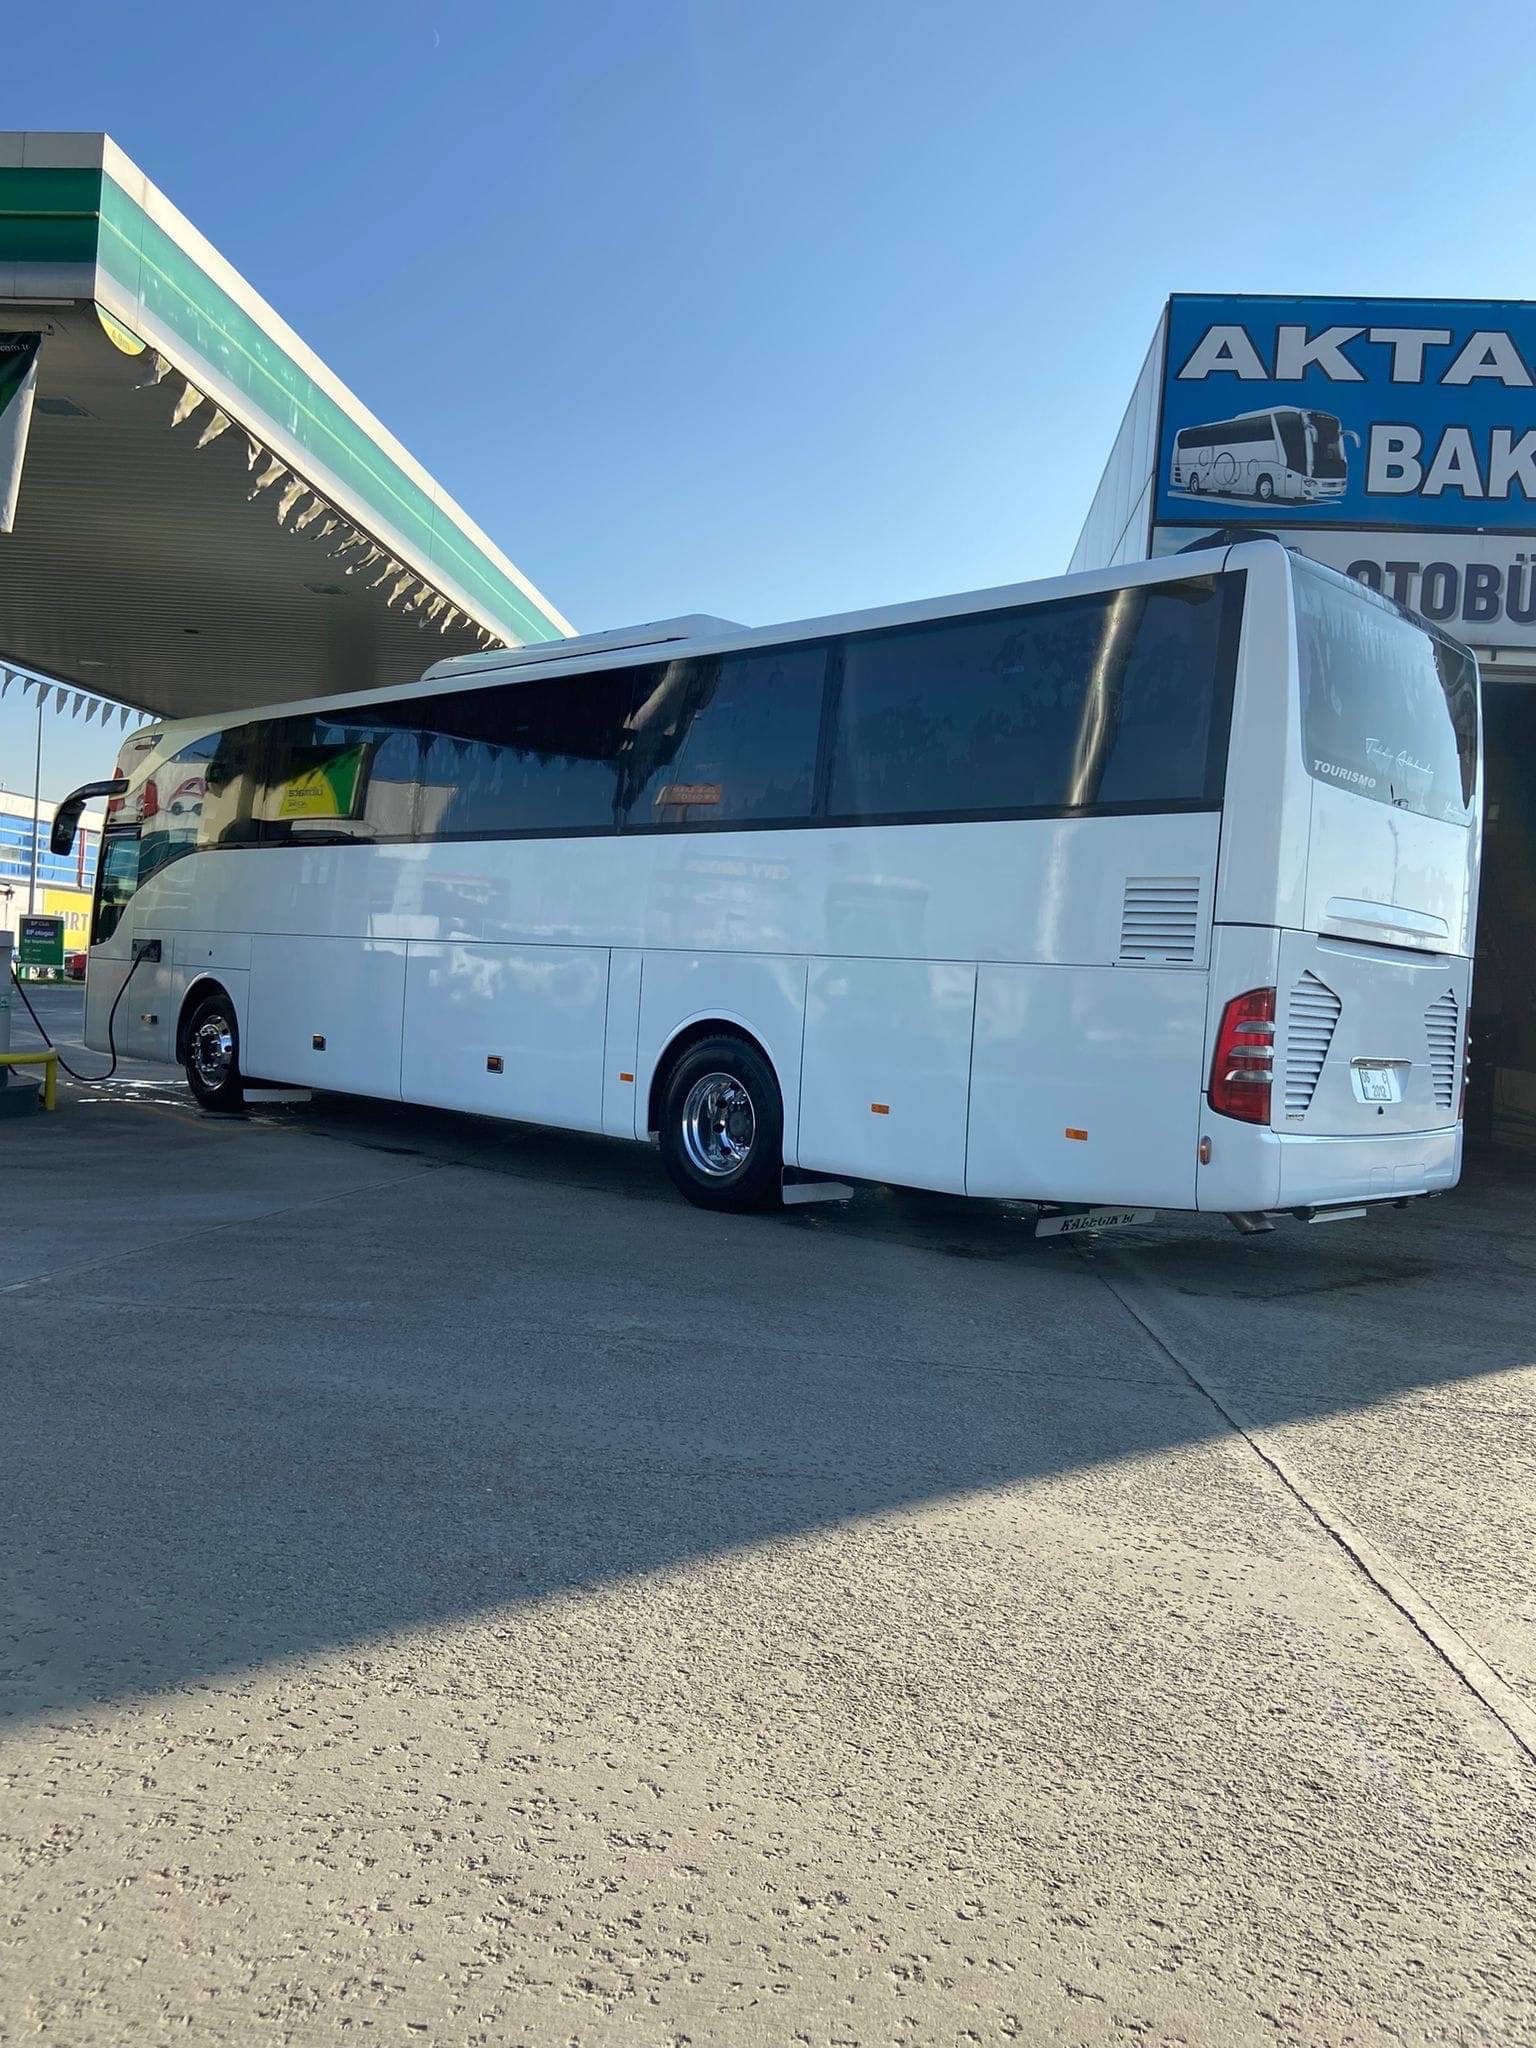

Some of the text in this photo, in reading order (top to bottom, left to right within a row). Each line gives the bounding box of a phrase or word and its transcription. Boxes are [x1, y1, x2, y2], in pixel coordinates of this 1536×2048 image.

[1367, 424, 1536, 498] BAK
[1346, 553, 1536, 623] OTOBÜ
[1313, 759, 1376, 788] TOURISMO
[54, 911, 89, 931] IRT
